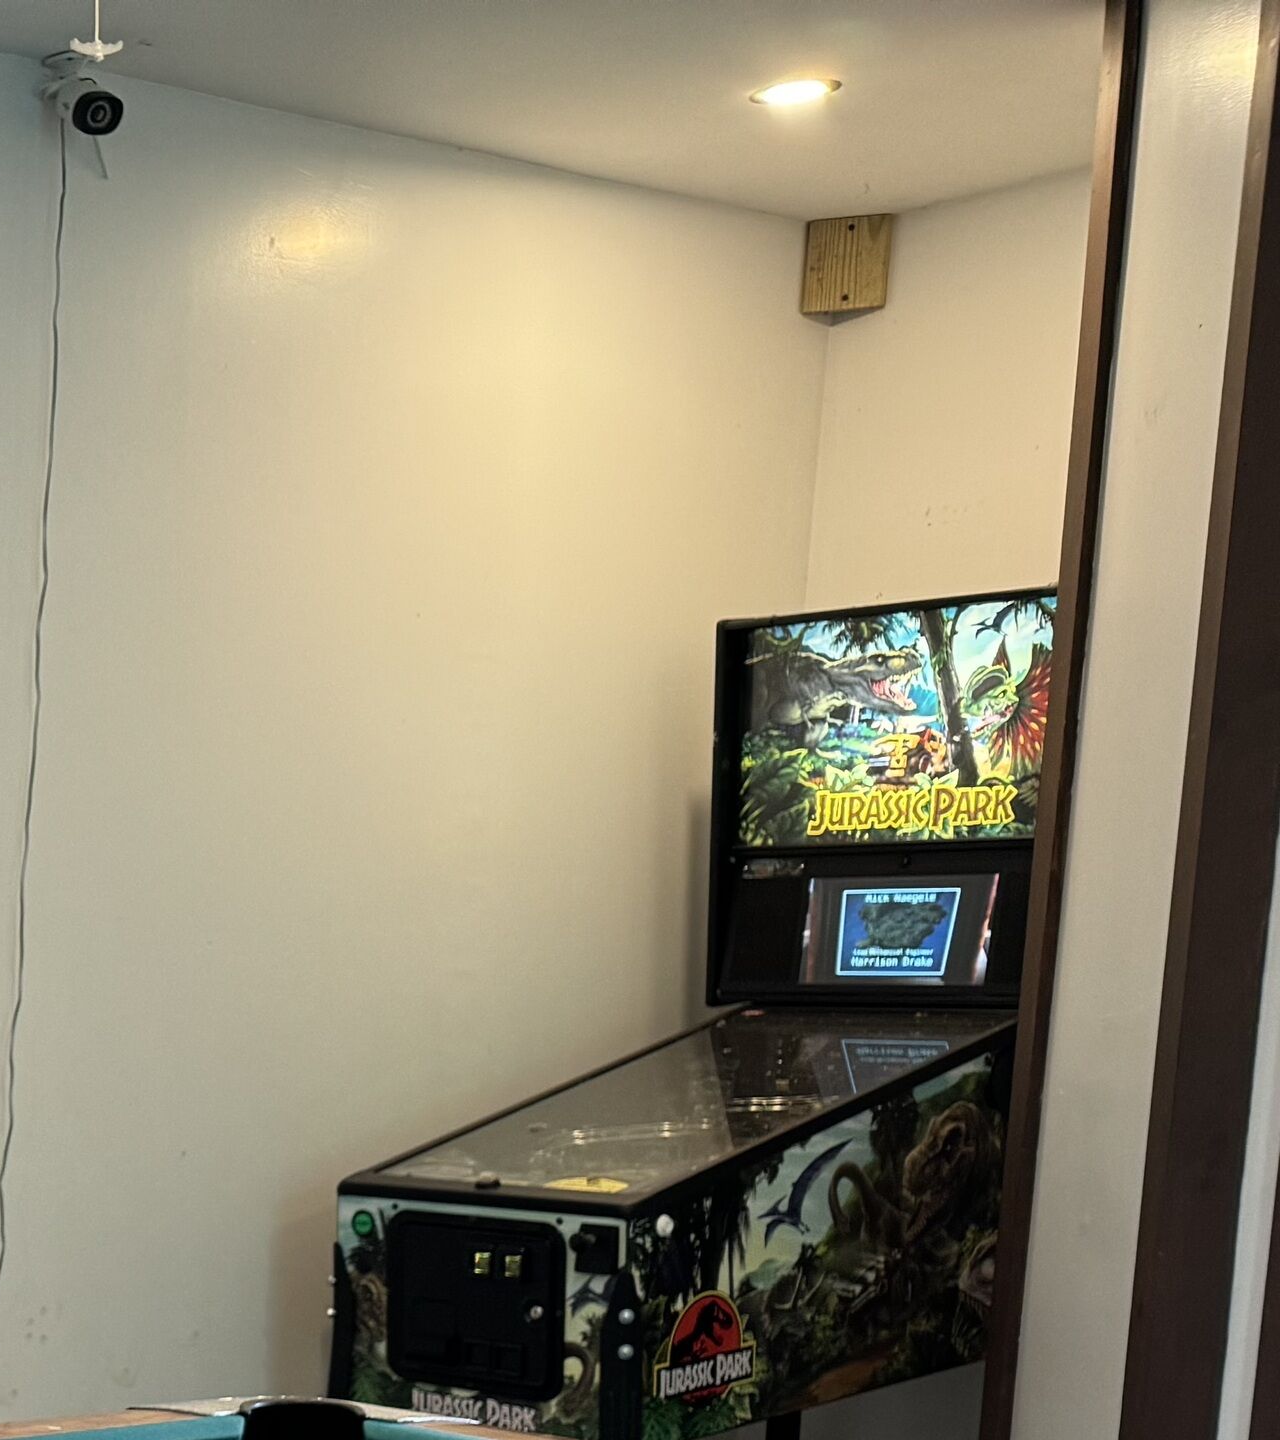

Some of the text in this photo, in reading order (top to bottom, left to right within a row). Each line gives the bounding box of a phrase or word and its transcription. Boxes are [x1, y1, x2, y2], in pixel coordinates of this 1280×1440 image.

[808, 785, 1018, 836] JURASSIC PARK
[660, 1350, 752, 1400] JURASSIC PARK
[411, 1388, 537, 1433] JURASSIC PARK
